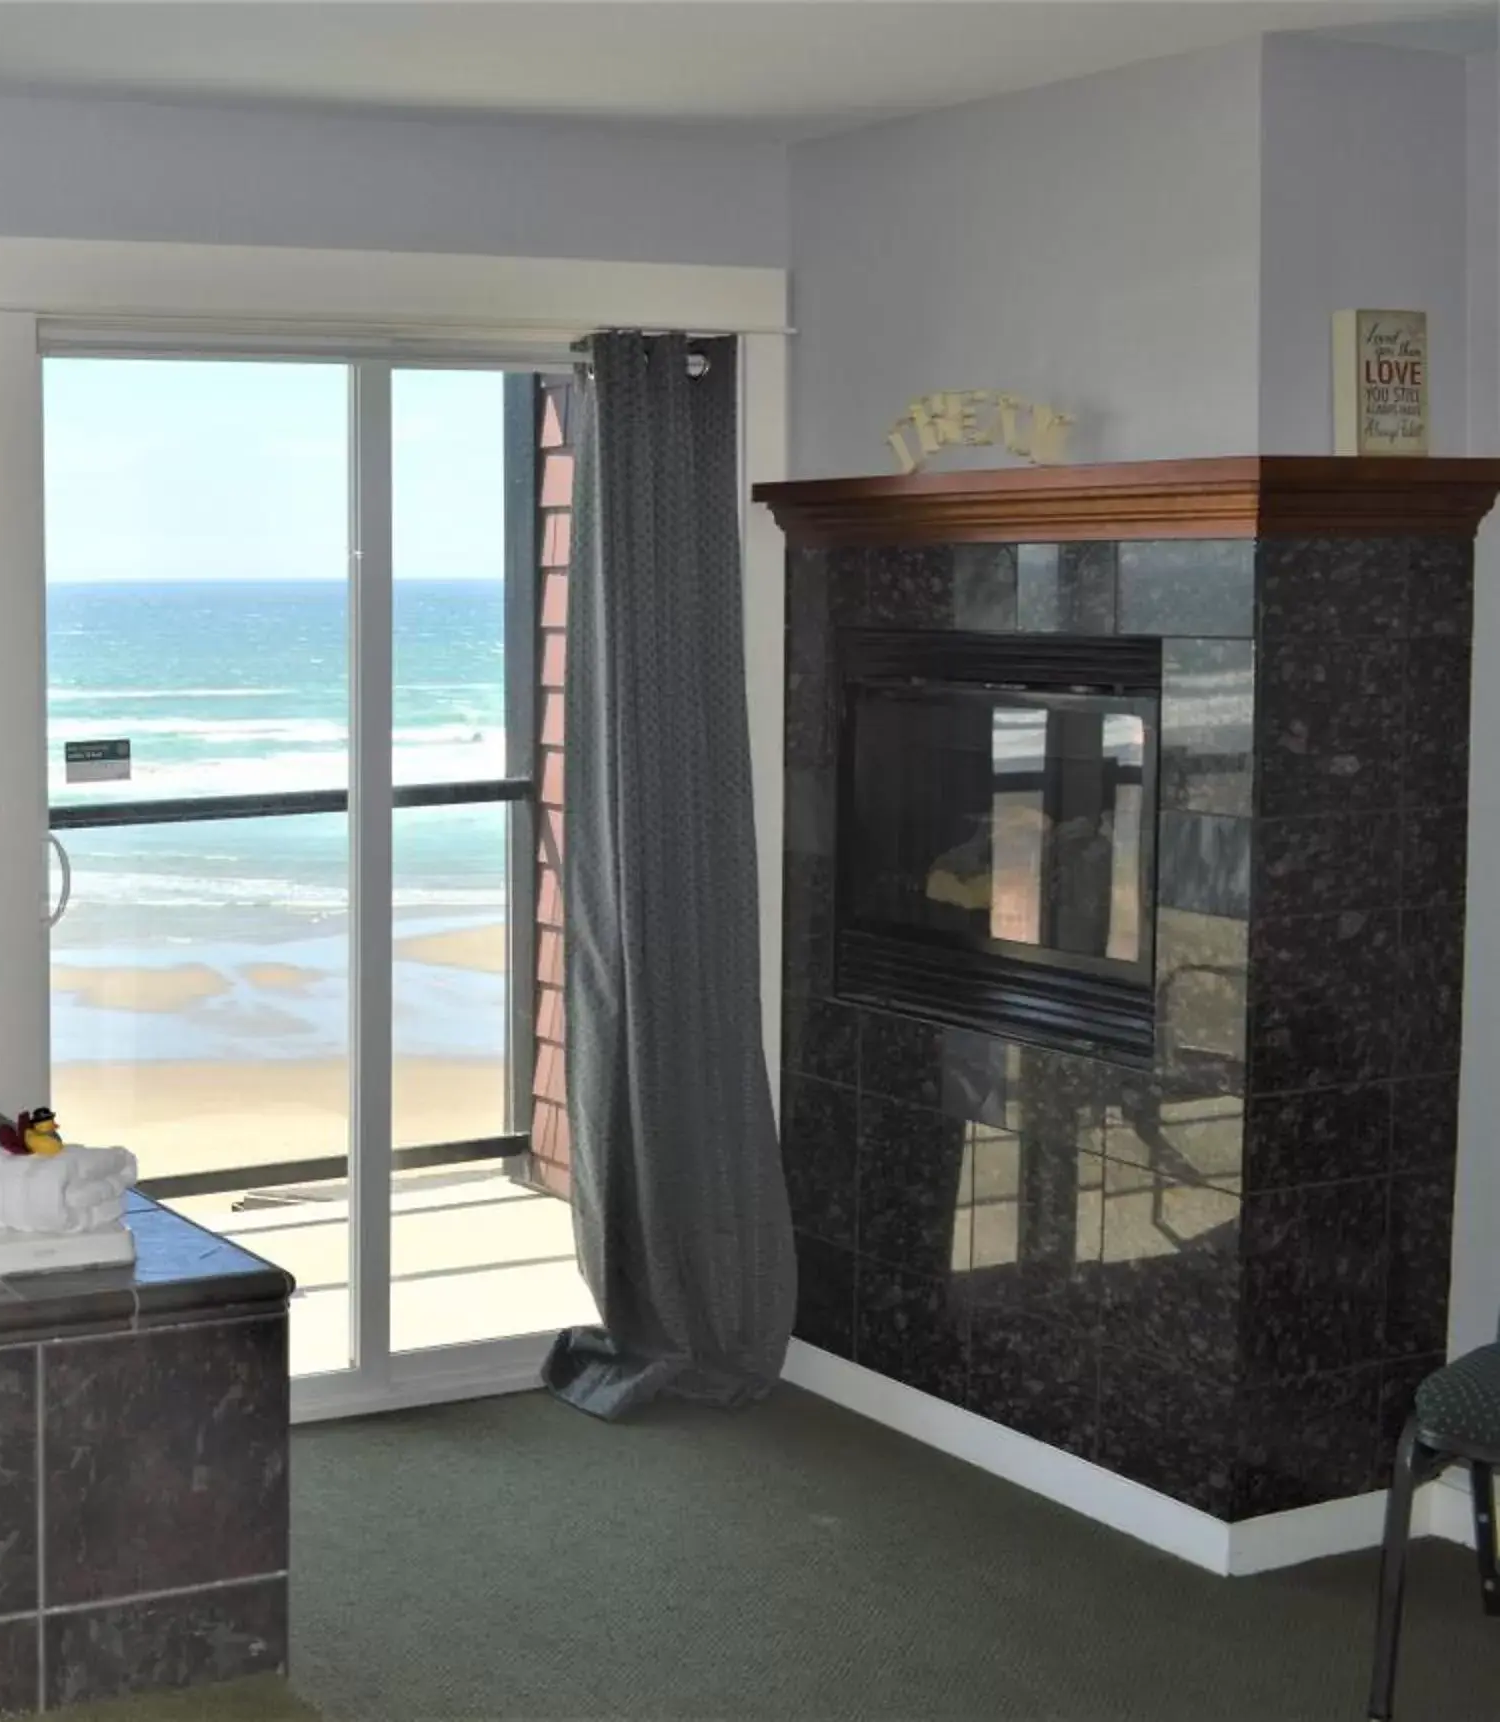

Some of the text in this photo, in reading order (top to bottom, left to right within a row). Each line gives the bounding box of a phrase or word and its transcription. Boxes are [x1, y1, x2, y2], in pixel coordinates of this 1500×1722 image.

[1365, 359, 1422, 386] LOVE
[1365, 386, 1421, 403] YOU STILL
